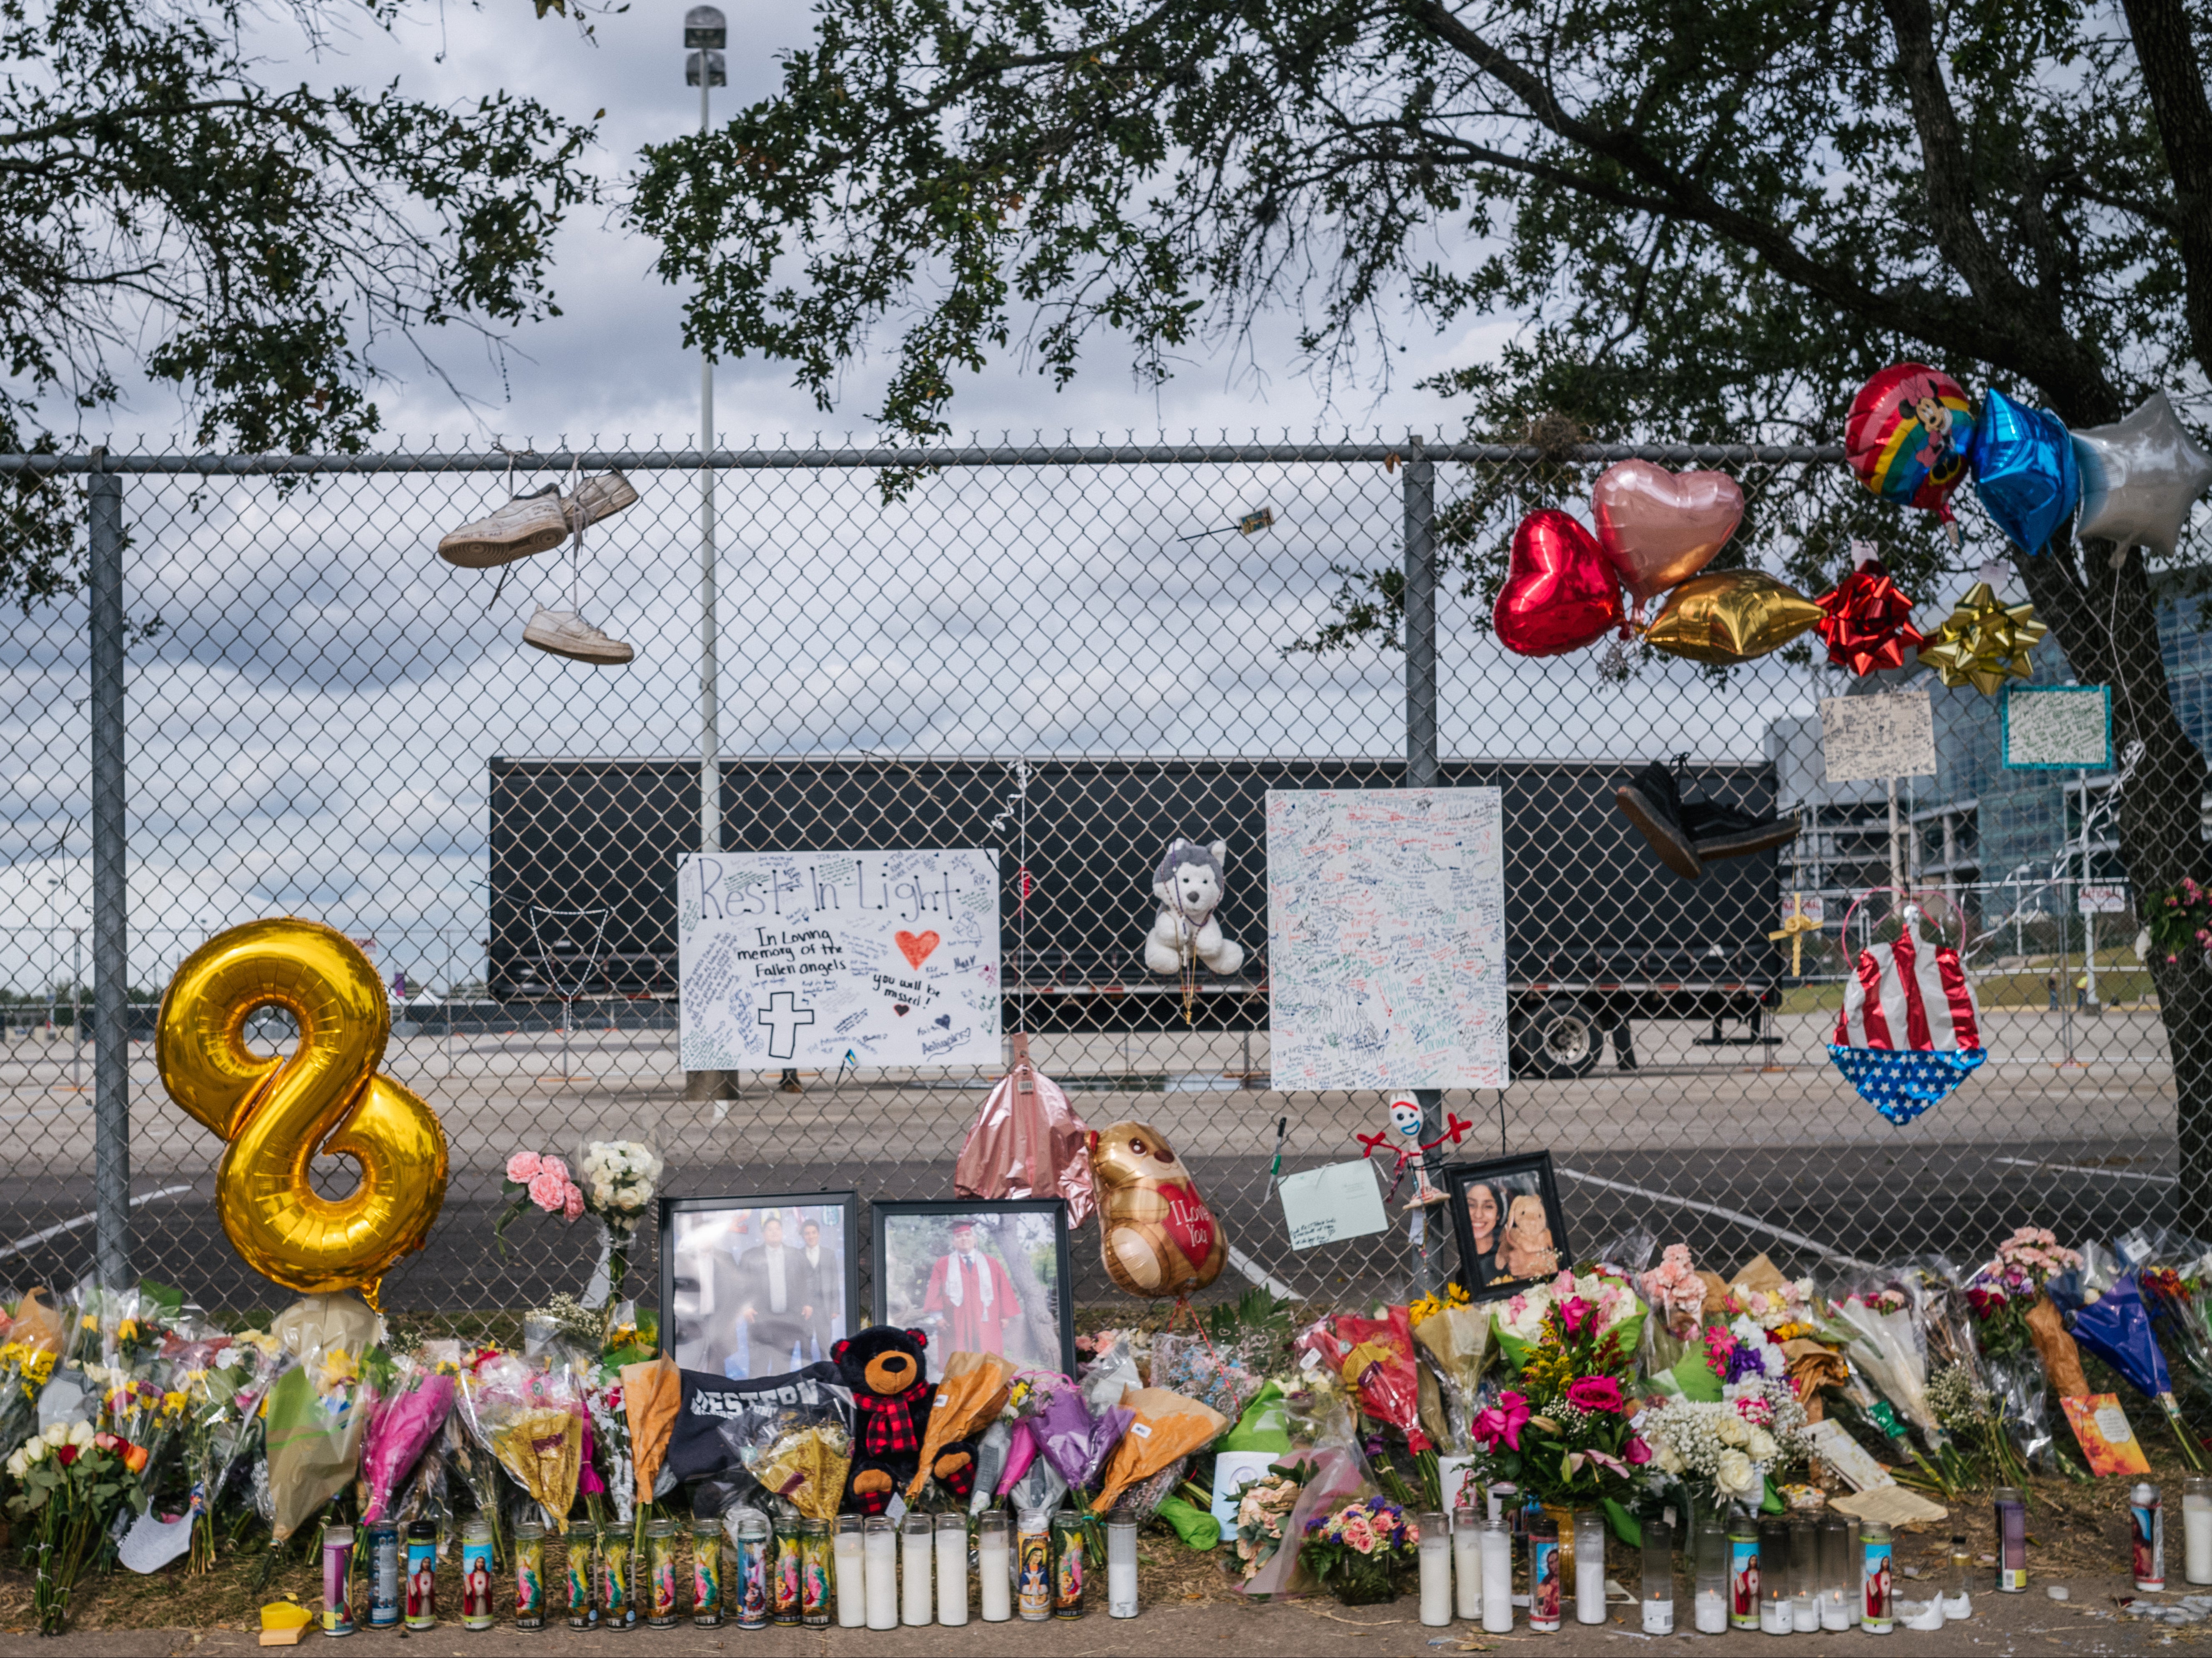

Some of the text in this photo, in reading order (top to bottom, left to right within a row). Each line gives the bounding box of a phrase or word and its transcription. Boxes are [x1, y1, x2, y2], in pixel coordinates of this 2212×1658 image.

[699, 857, 796, 919] Rest
[810, 866, 840, 912] In
[856, 859, 961, 922] Light
[755, 926, 777, 947] In
[782, 929, 834, 947] Loving
[737, 946, 795, 962] memory
[800, 944, 816, 955] of
[799, 959, 847, 976] angels
[873, 974, 940, 998] you will be
[1170, 1200, 1209, 1226] I Love
[1186, 1224, 1208, 1247] You
